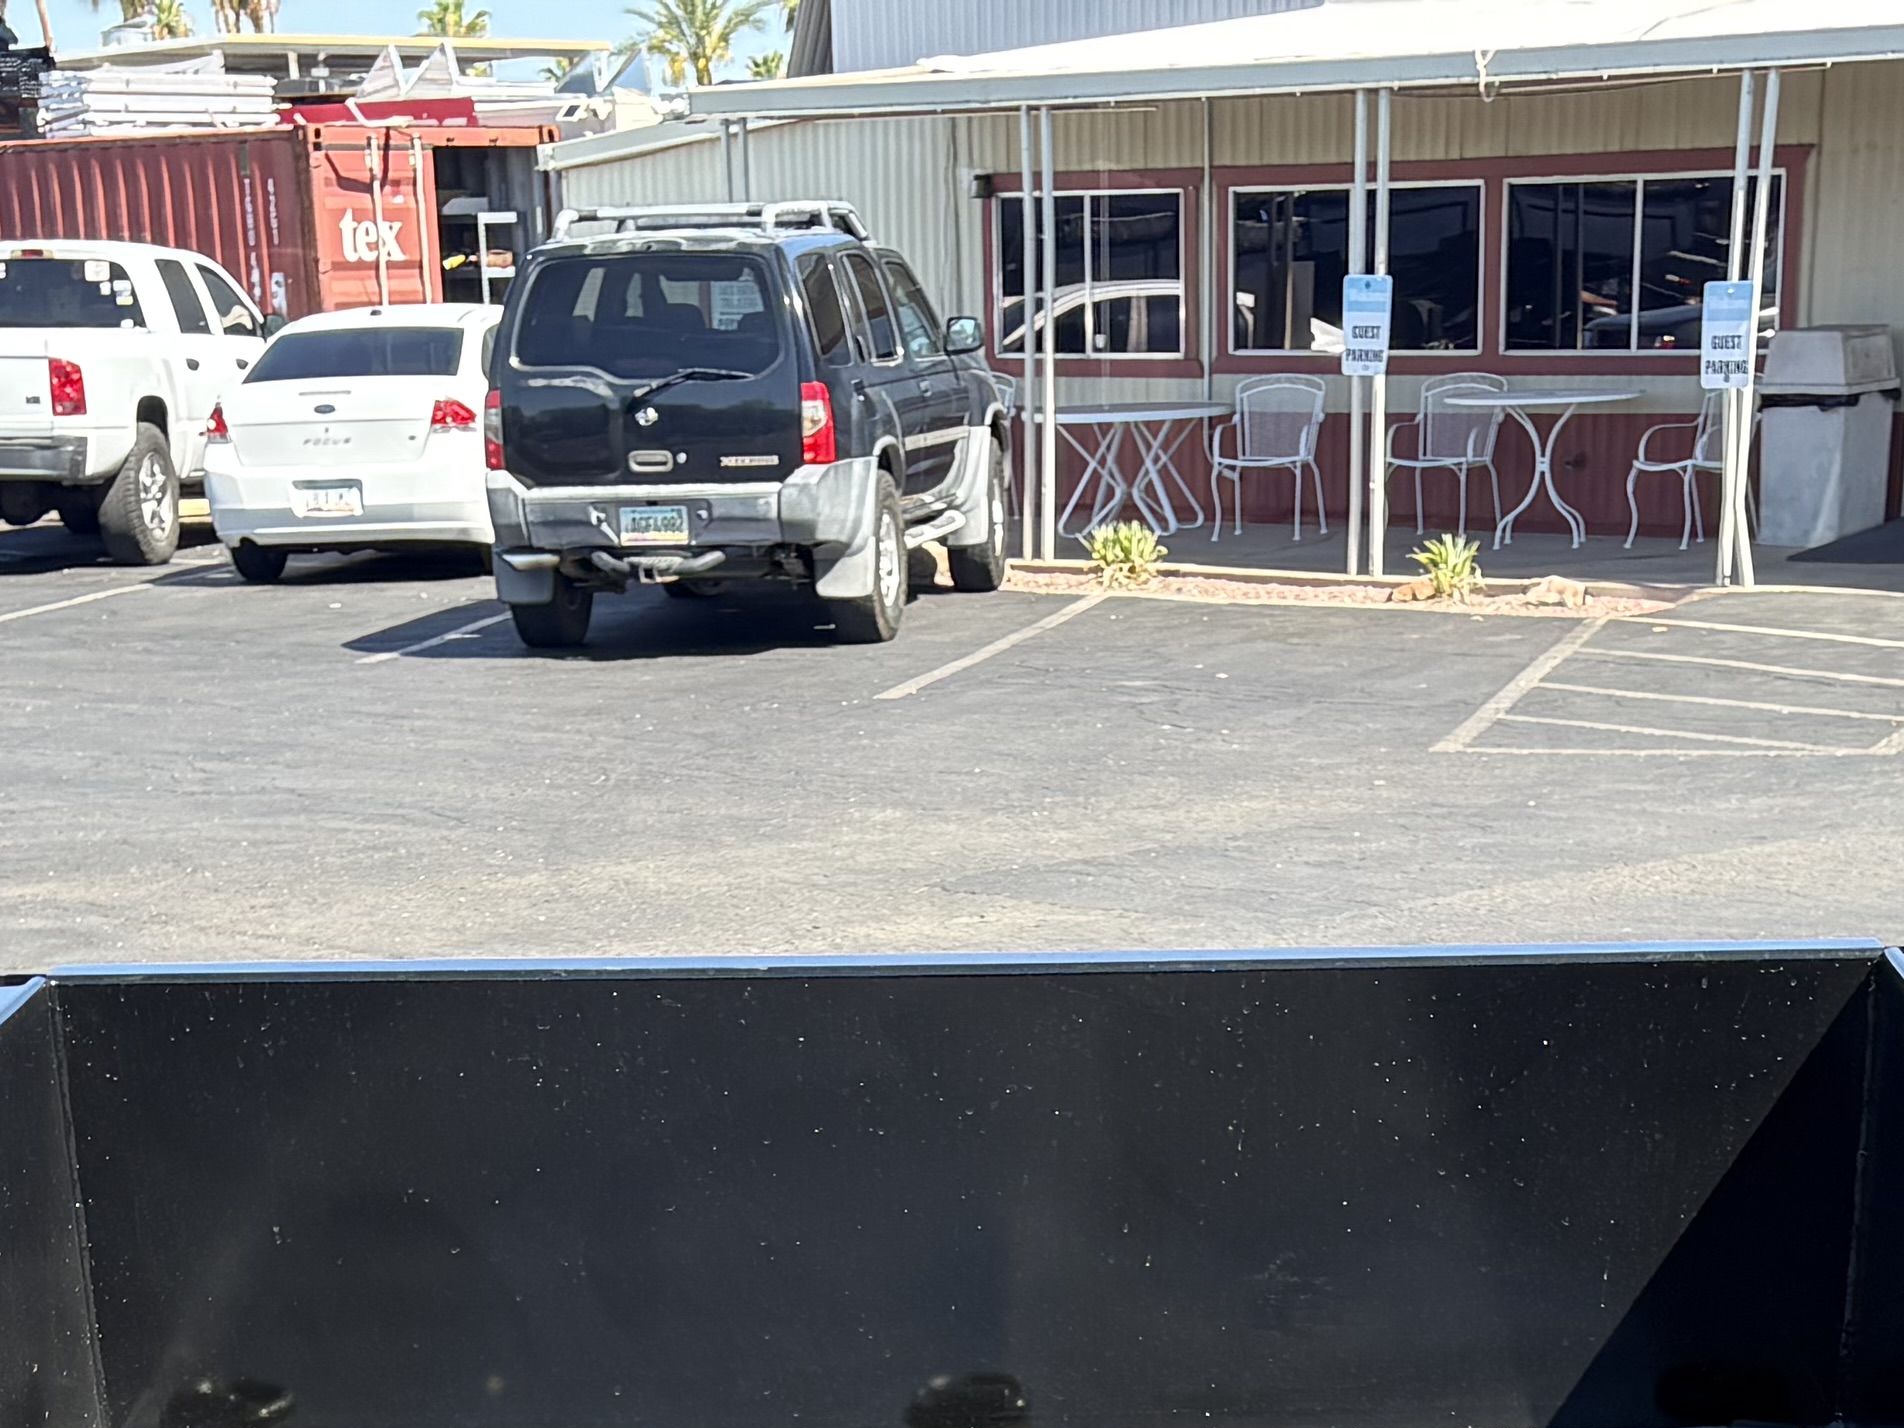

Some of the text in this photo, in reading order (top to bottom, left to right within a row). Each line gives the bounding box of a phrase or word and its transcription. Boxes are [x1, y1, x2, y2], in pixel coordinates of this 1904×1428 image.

[339, 208, 408, 262] tex
[1352, 325, 1382, 340] GUEST
[1711, 334, 1744, 350] GUEST
[1345, 348, 1385, 363] PARKING
[1705, 360, 1749, 375] PARKING
